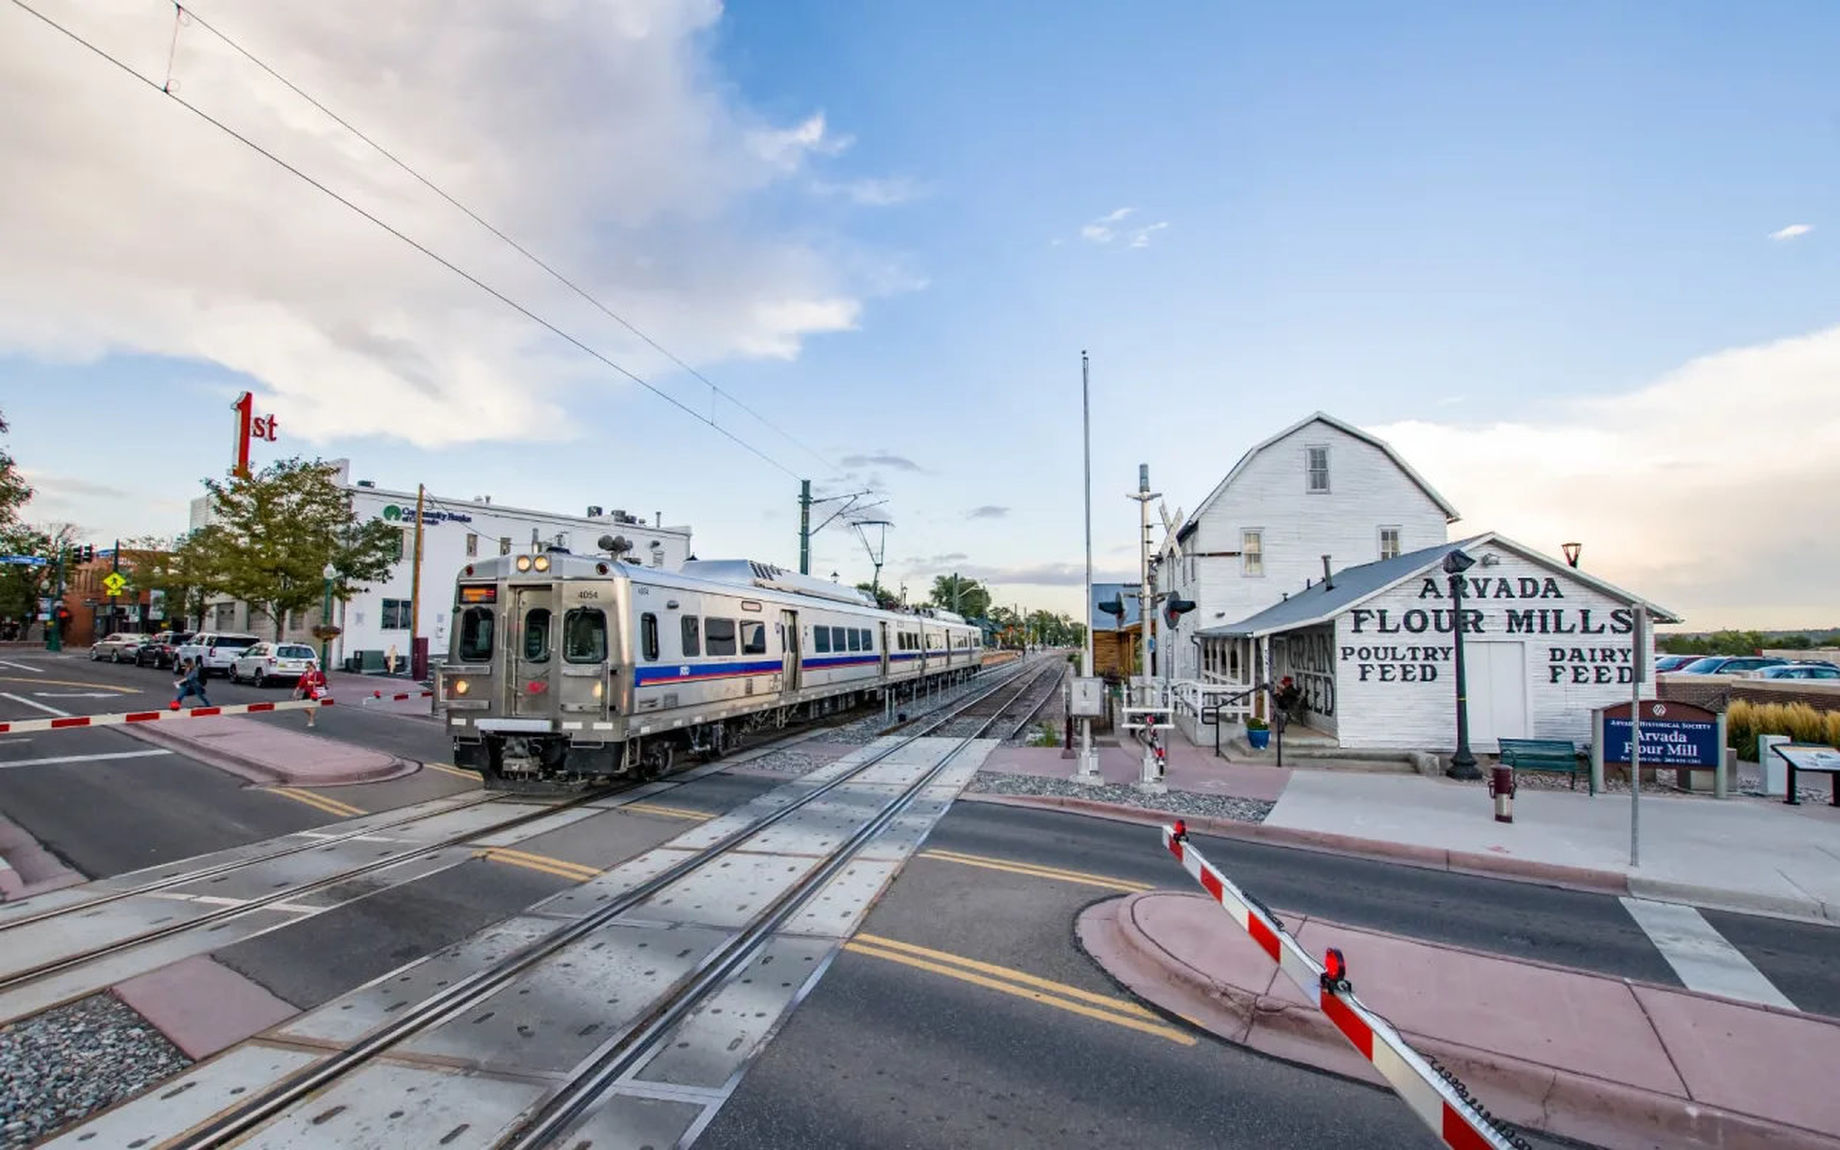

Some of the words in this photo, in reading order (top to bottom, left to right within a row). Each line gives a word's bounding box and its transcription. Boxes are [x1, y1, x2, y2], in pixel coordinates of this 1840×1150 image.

[231, 391, 277, 478] 1st
[578, 591, 598, 599] 4054
[1418, 578, 1564, 599] ARVADA
[1351, 609, 1485, 633] FLOUR
[1505, 609, 1633, 634] MILLS
[1341, 647, 1454, 661] POULTRY
[1549, 648, 1632, 662] DAIRY
[1358, 664, 1438, 681] FEED
[1549, 665, 1633, 684] FEED
[1638, 730, 1687, 743] Arvada
[1624, 742, 1663, 754] Four
[1667, 744, 1697, 757] Mill
